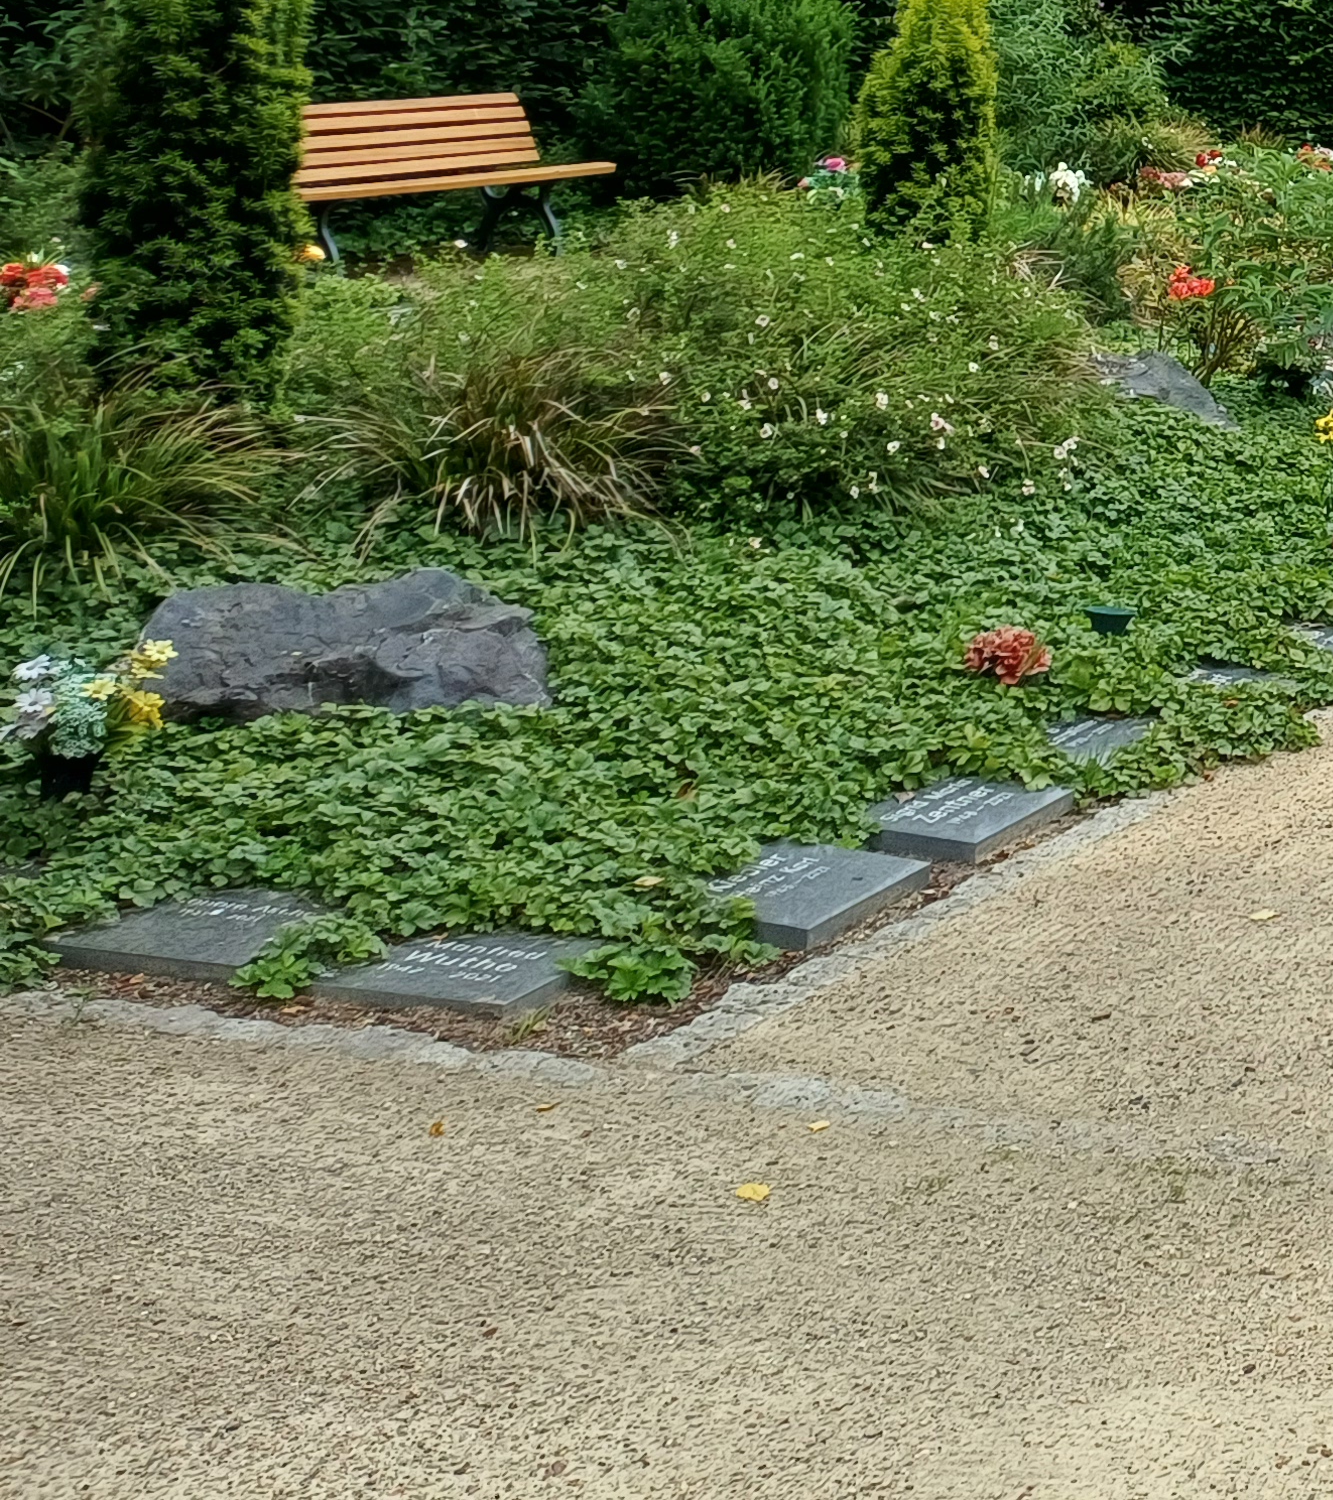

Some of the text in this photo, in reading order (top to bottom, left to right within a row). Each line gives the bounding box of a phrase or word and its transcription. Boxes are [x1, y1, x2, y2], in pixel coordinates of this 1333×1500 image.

[912, 785, 995, 824] Zentner
[425, 941, 548, 960] Manfred
[404, 950, 518, 972] Wuthe
[448, 970, 503, 983] 2021
